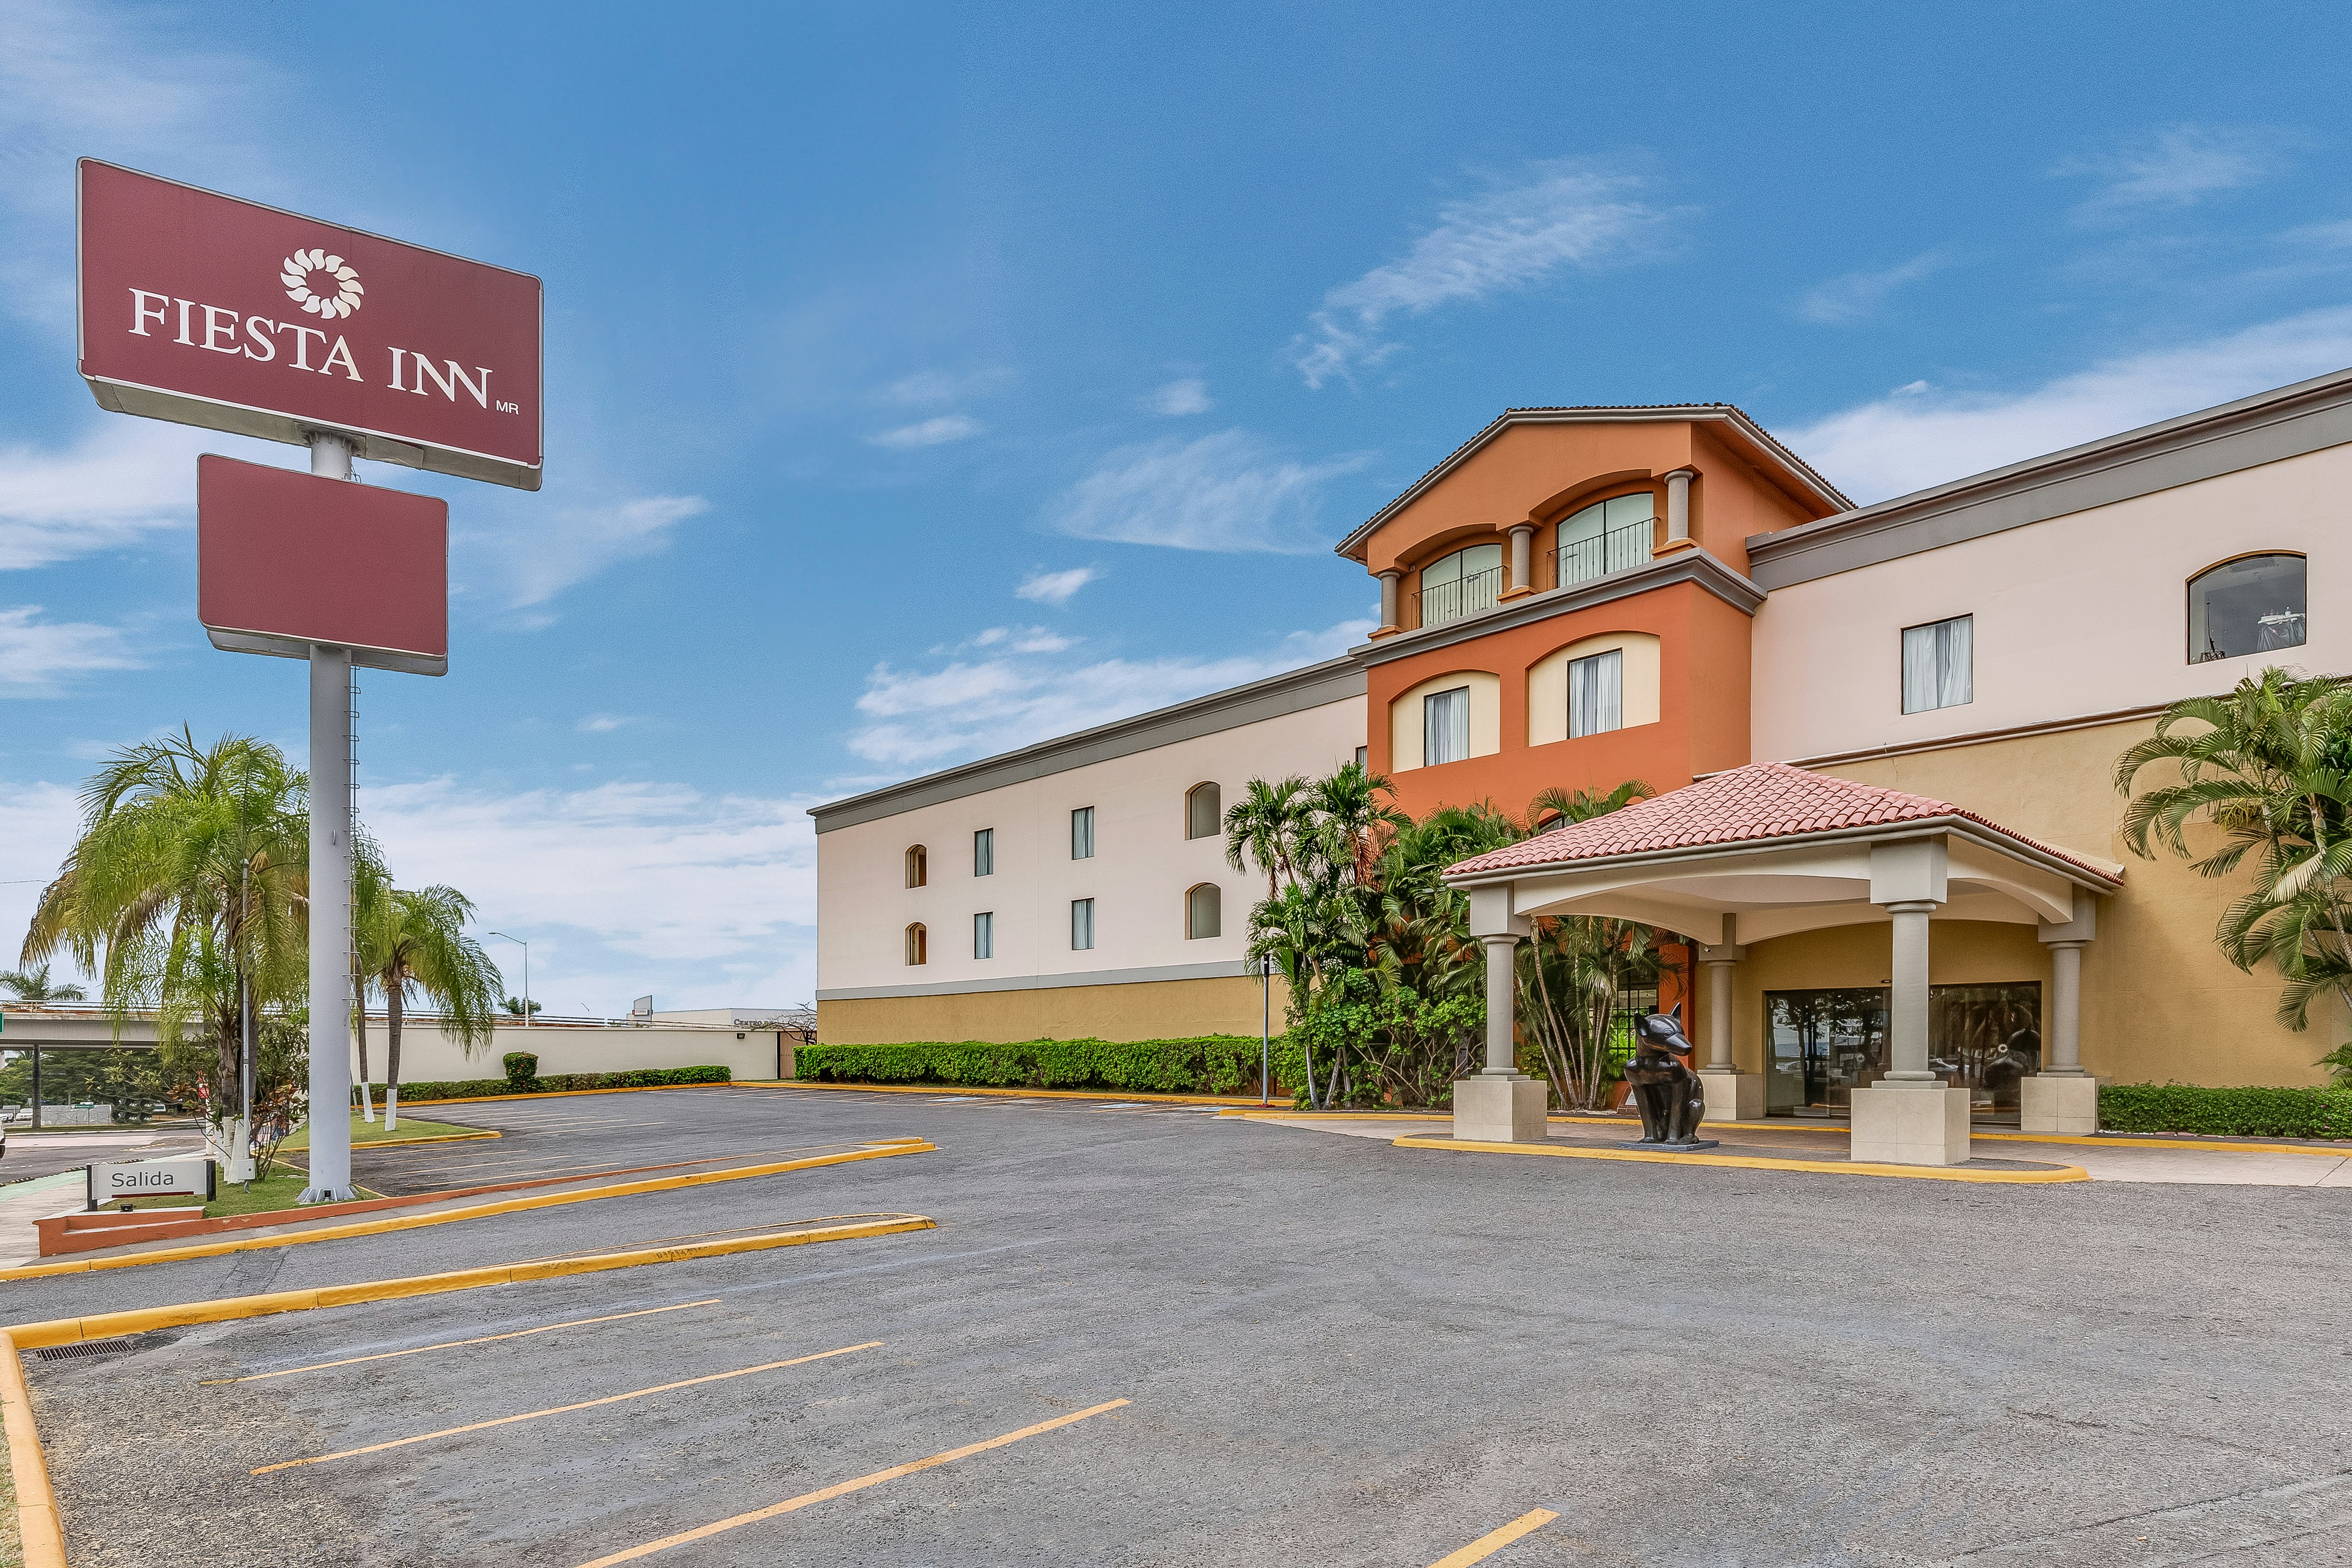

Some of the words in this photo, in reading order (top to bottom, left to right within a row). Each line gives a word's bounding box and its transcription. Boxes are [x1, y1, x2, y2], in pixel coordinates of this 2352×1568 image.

[128, 287, 364, 382] FIESTA
[387, 346, 493, 409] INN
[496, 400, 519, 415] MR
[111, 1171, 174, 1187] Salida
